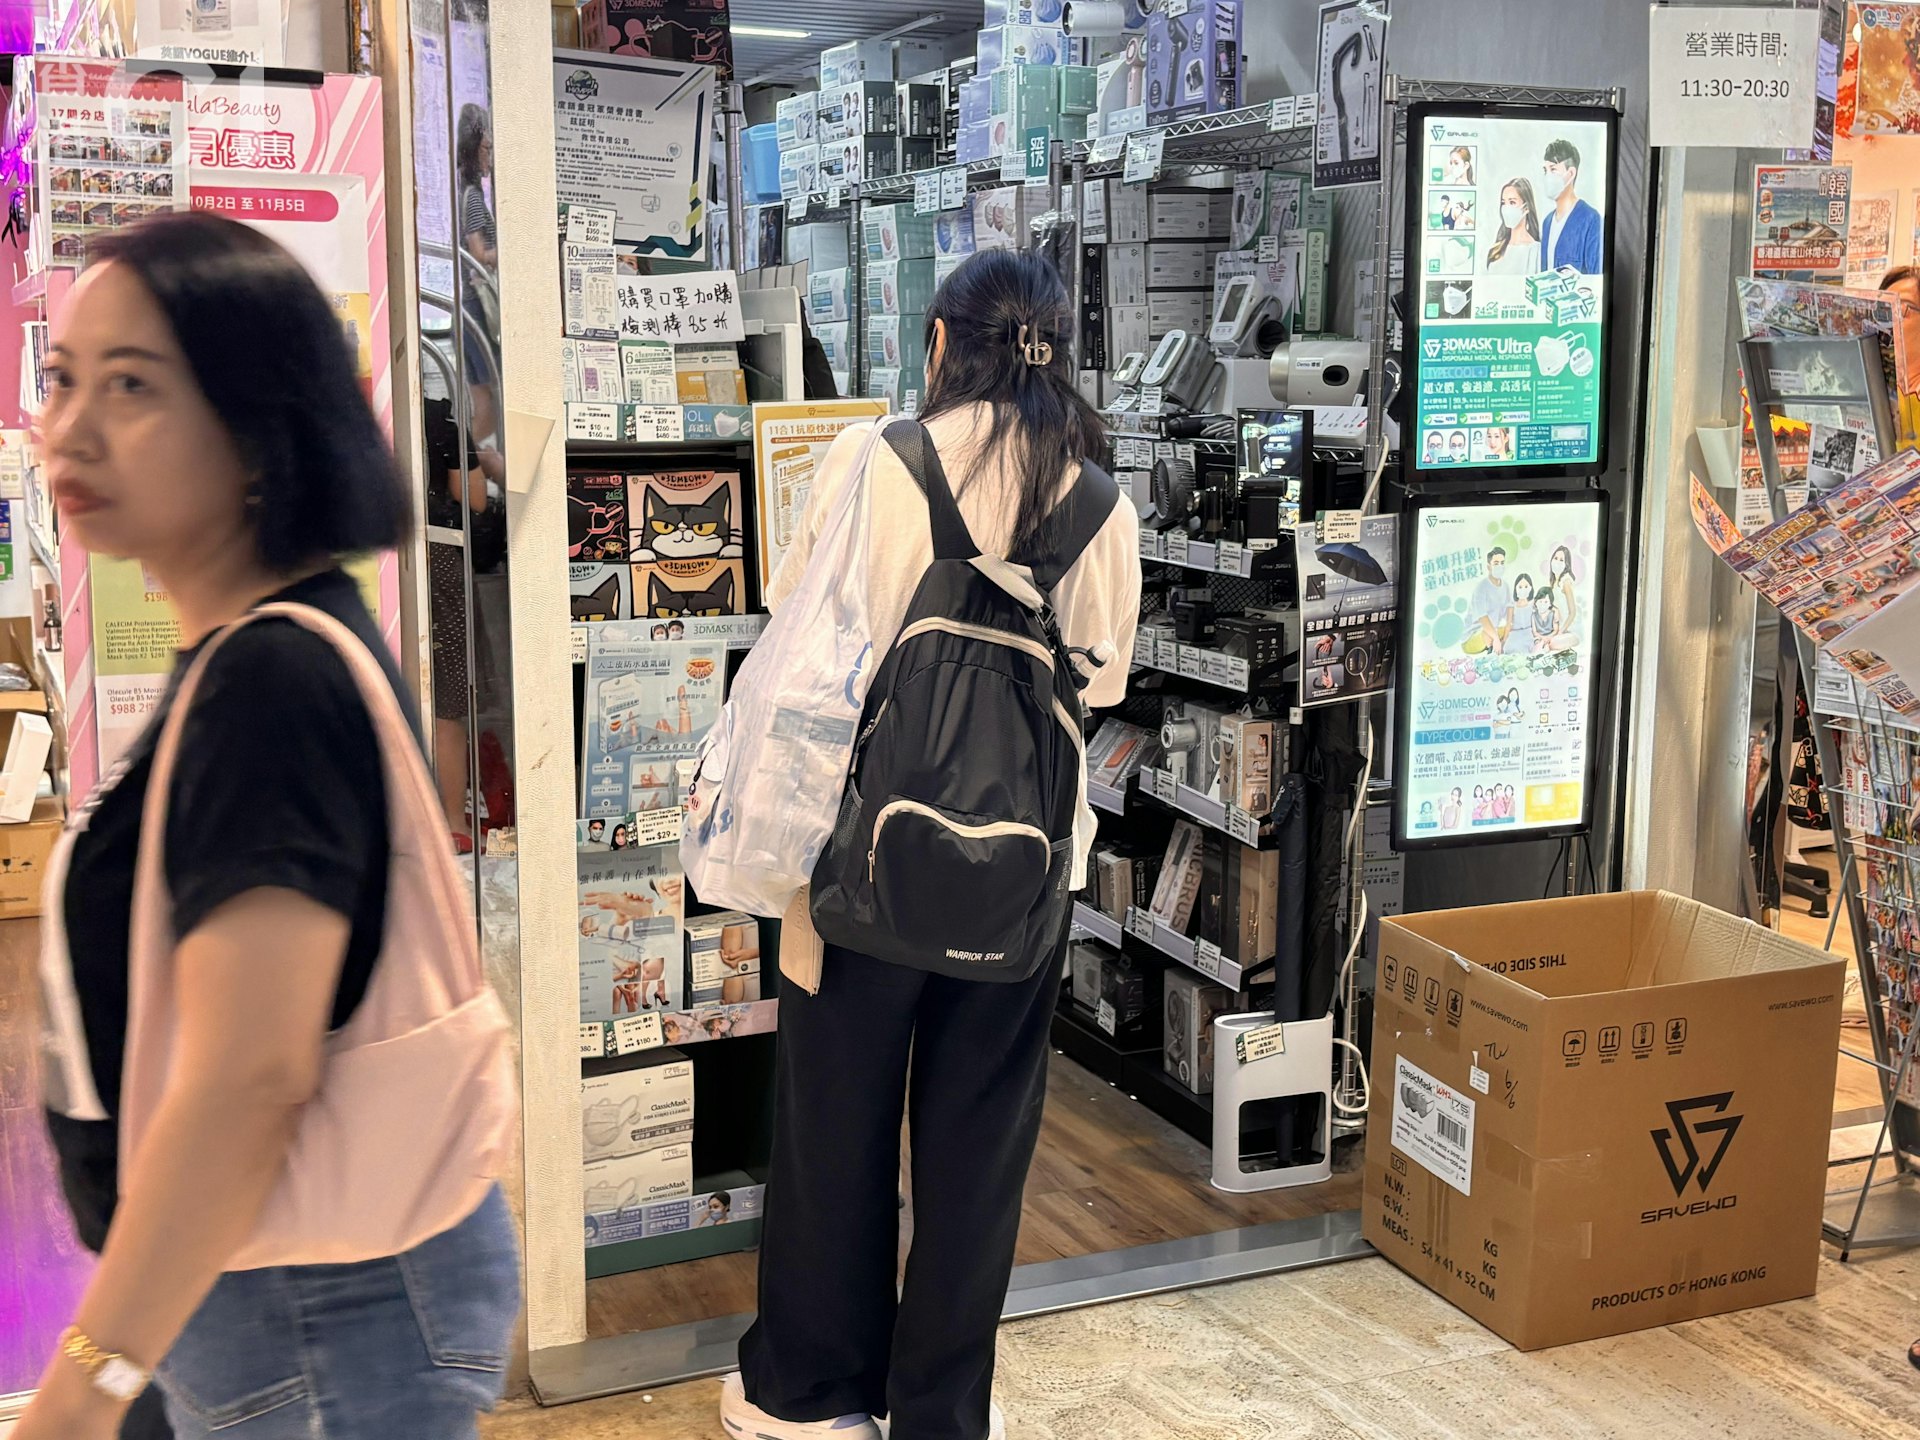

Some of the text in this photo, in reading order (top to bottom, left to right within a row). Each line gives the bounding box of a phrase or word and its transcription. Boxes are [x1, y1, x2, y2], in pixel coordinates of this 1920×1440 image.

[1685, 32, 1787, 58] 營業時間:
[1681, 79, 1790, 98] 11:30-20:30
[1030, 137, 1045, 150] SIZE
[1030, 151, 1045, 168] 175
[241, 197, 254, 210] 至
[258, 198, 305, 212] 11月5日
[1442, 337, 1532, 354] 3DMASK Ultra
[665, 473, 702, 483] 3DMEOW
[669, 561, 706, 570] 3DMEOW
[692, 623, 733, 635] 3DMASK
[107, 688, 132, 696] Olecule
[110, 704, 136, 715] $988
[657, 831, 671, 840] $29
[945, 949, 1005, 962] WARRIOR STAR
[1510, 952, 1567, 974] THIS SIDE
[1768, 994, 1835, 1013] www.savewo.com
[1470, 999, 1529, 1032] www.savewo.com
[1399, 1064, 1433, 1092] ClassicMask
[650, 1098, 688, 1112] ClassicMask
[648, 1180, 687, 1194] ClassicMask
[1641, 1195, 1737, 1224] SAVEWO
[1483, 1238, 1499, 1258] KG
[1421, 1242, 1432, 1258] 54
[1443, 1257, 1454, 1275] 41
[1465, 1273, 1477, 1289] 52
[1479, 1281, 1496, 1302] CM
[1482, 1259, 1497, 1280] KG
[1591, 1266, 1767, 1311] PRODUCTS OF HONG KONG
